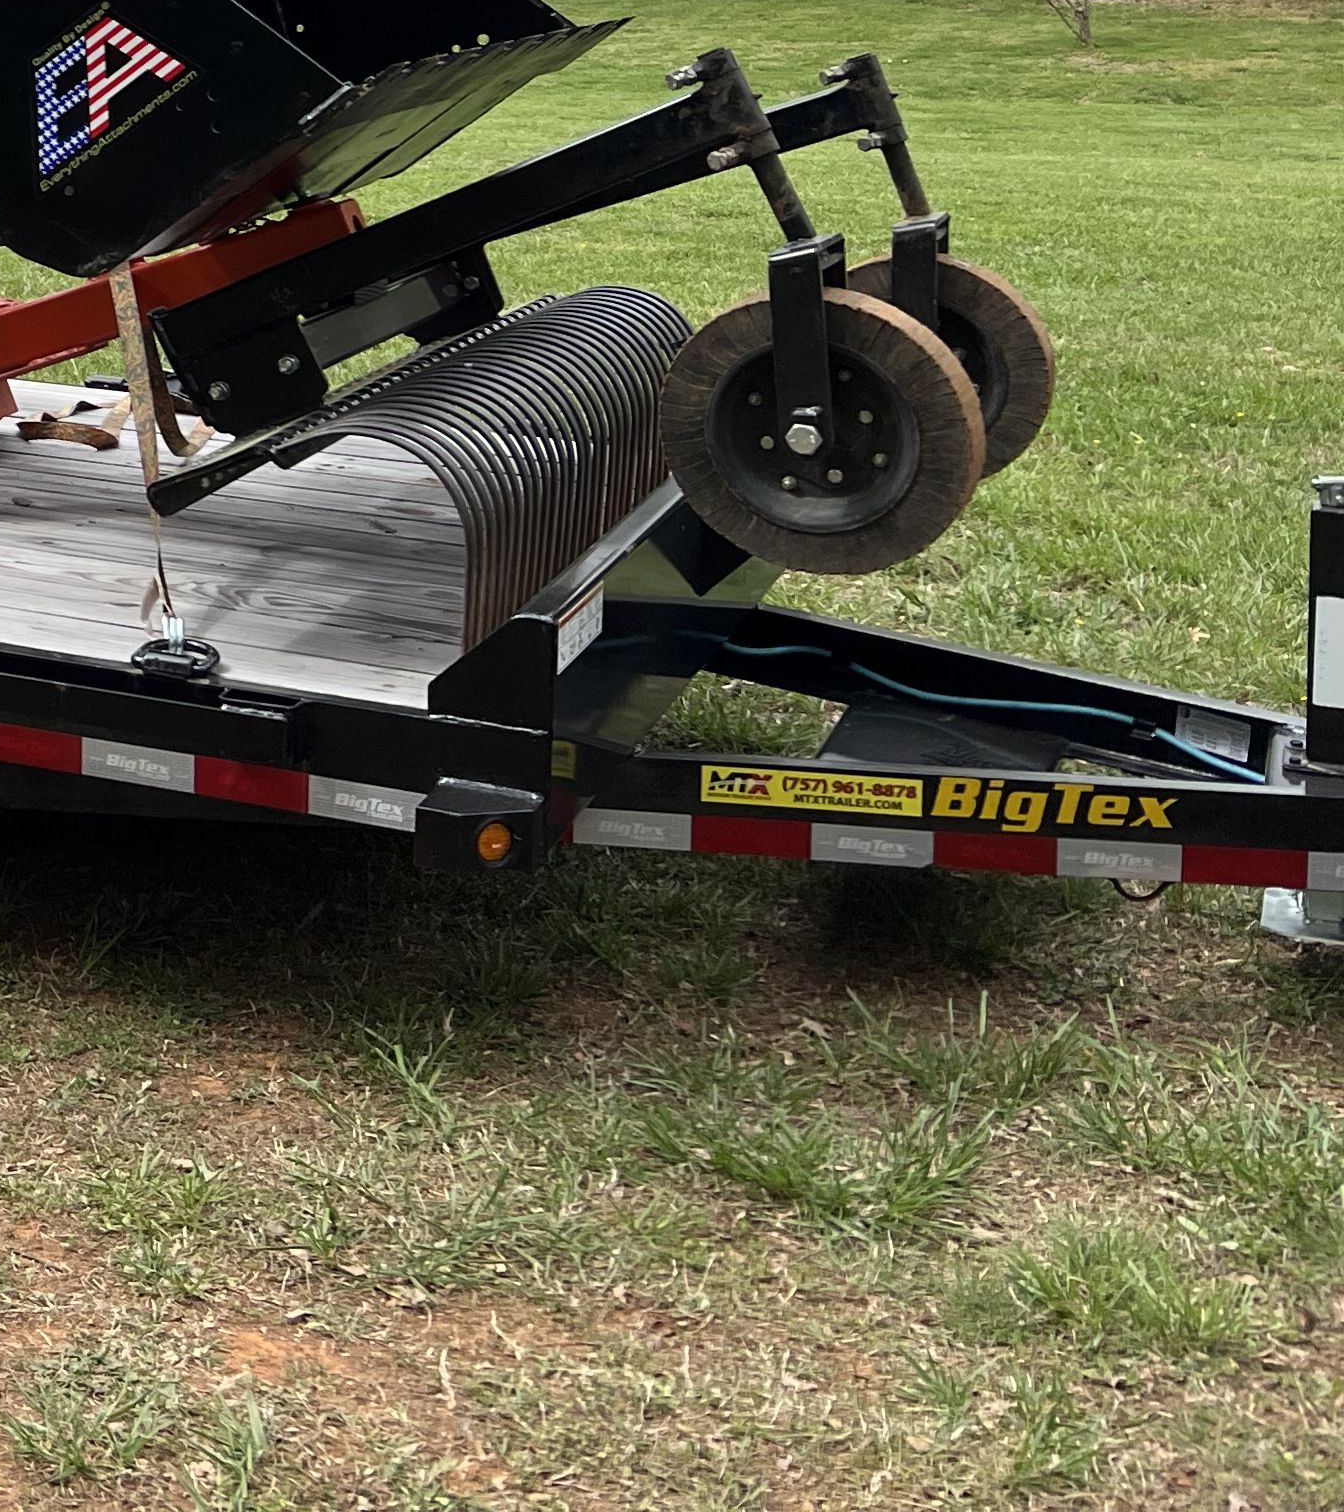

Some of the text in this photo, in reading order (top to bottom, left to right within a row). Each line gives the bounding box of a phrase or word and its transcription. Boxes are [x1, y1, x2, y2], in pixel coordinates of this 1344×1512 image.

[35, 16, 186, 175] EA
[39, 70, 198, 192] EverythingAttachments.com
[105, 753, 171, 773] BigTex
[782, 776, 917, 799] (757) 961-8878
[335, 792, 405, 815] BigTex
[793, 794, 903, 811] MTXTRAILER.COM
[930, 777, 1179, 833] BigTex
[598, 820, 665, 836] BigTex
[837, 837, 908, 854] BigTex
[1083, 852, 1155, 867] BigTex
